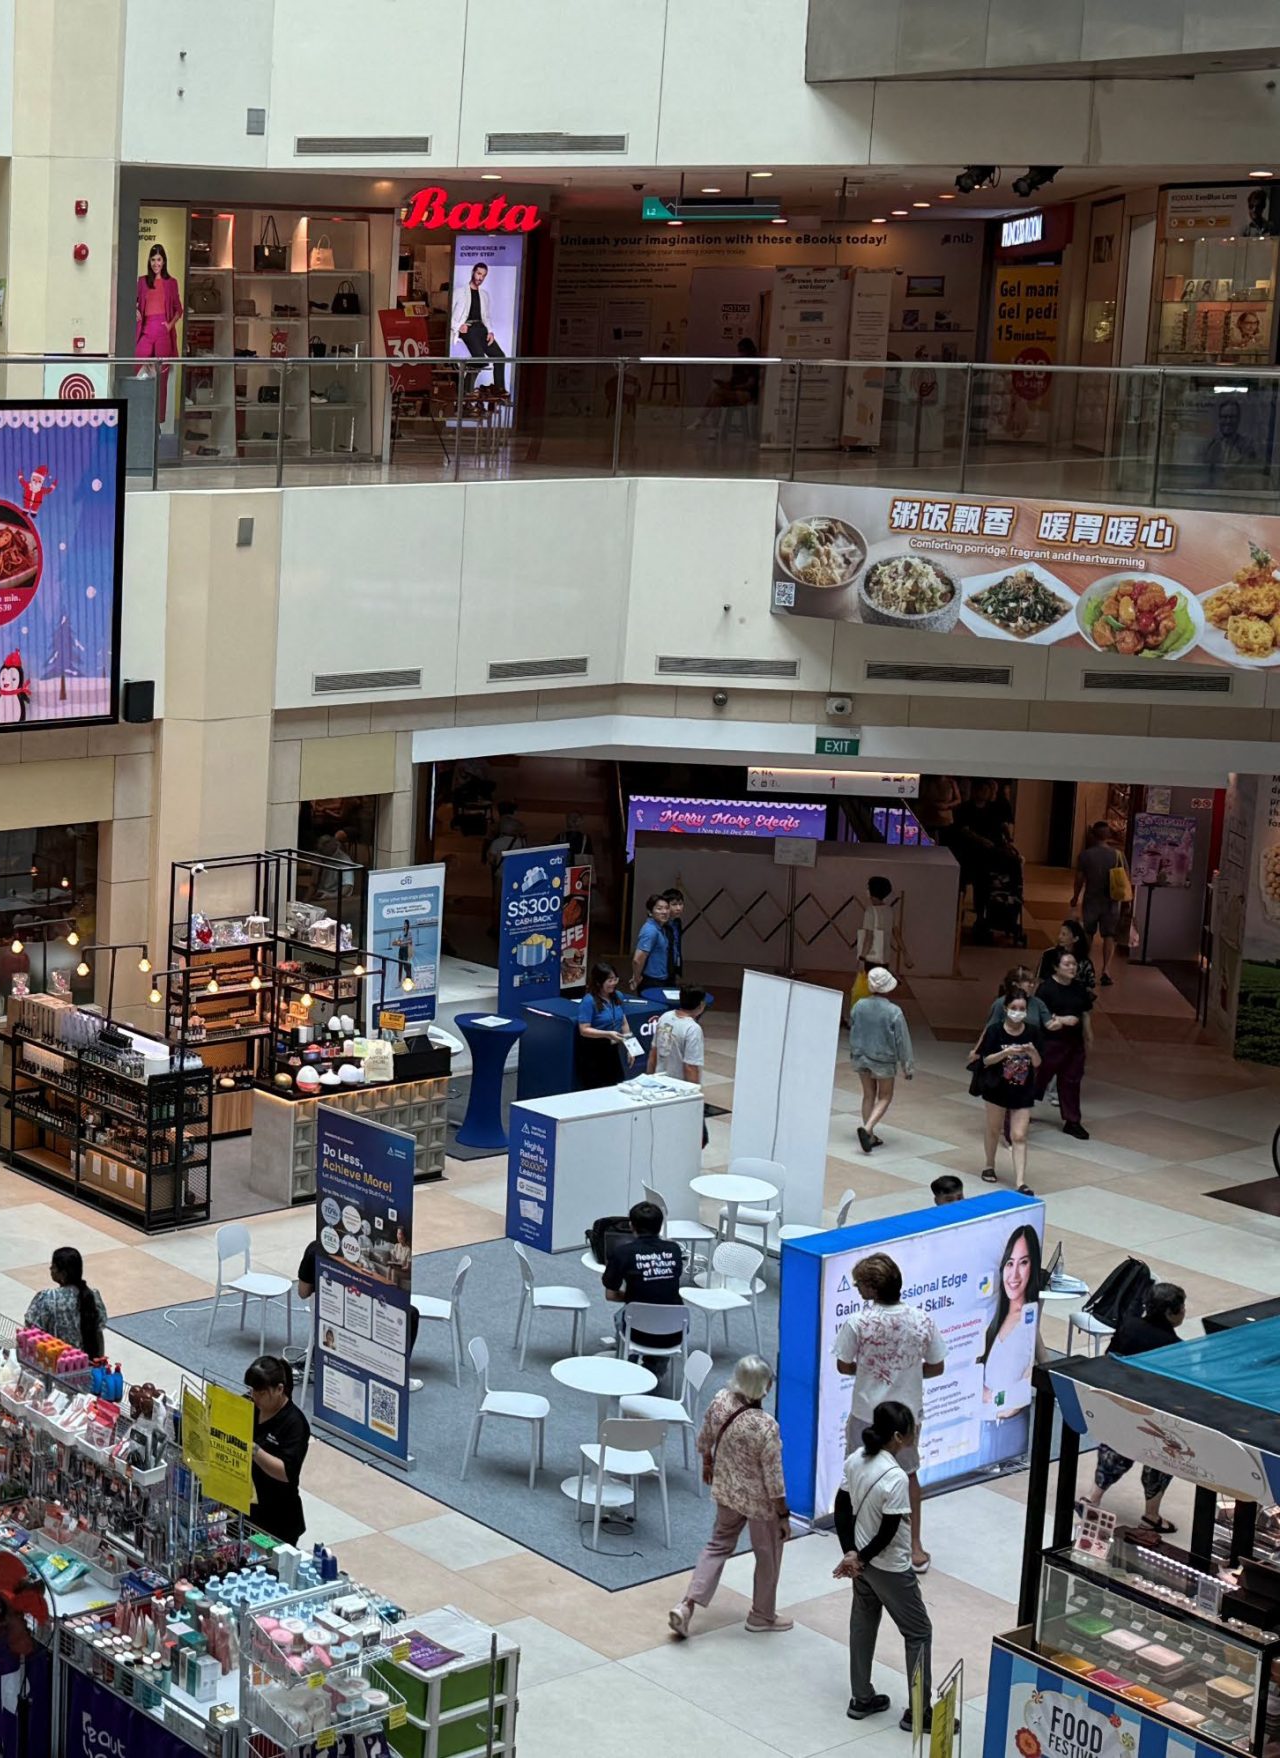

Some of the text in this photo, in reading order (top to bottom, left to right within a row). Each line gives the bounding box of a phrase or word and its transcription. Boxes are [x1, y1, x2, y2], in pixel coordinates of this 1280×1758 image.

[401, 186, 542, 232] Bata
[560, 232, 887, 247] Unleash your imagination with these eBooks today!
[1000, 280, 1059, 297] Gel mani
[998, 302, 1058, 323] Gel pedi
[889, 500, 1174, 550] 粥饭飘香 暖胃暖心
[910, 538, 1146, 569] Comforting porridge, fragrant and heartwarming
[824, 740, 850, 753] EXIT
[829, 776, 836, 789] 1
[660, 809, 802, 832] Merry More Edeals
[401, 876, 412, 885] citi
[507, 895, 561, 919] S$300
[514, 916, 533, 926] CASH
[322, 1142, 364, 1170] Do Less,
[322, 1157, 392, 1193] Achieve More!
[635, 1251, 673, 1261] Ready for
[636, 1262, 651, 1270] the
[643, 1267, 673, 1276] of Work
[900, 1271, 968, 1300] ssional Edge
[835, 1295, 955, 1317] Gain Skills.
[1050, 1705, 1103, 1754] FOOD
